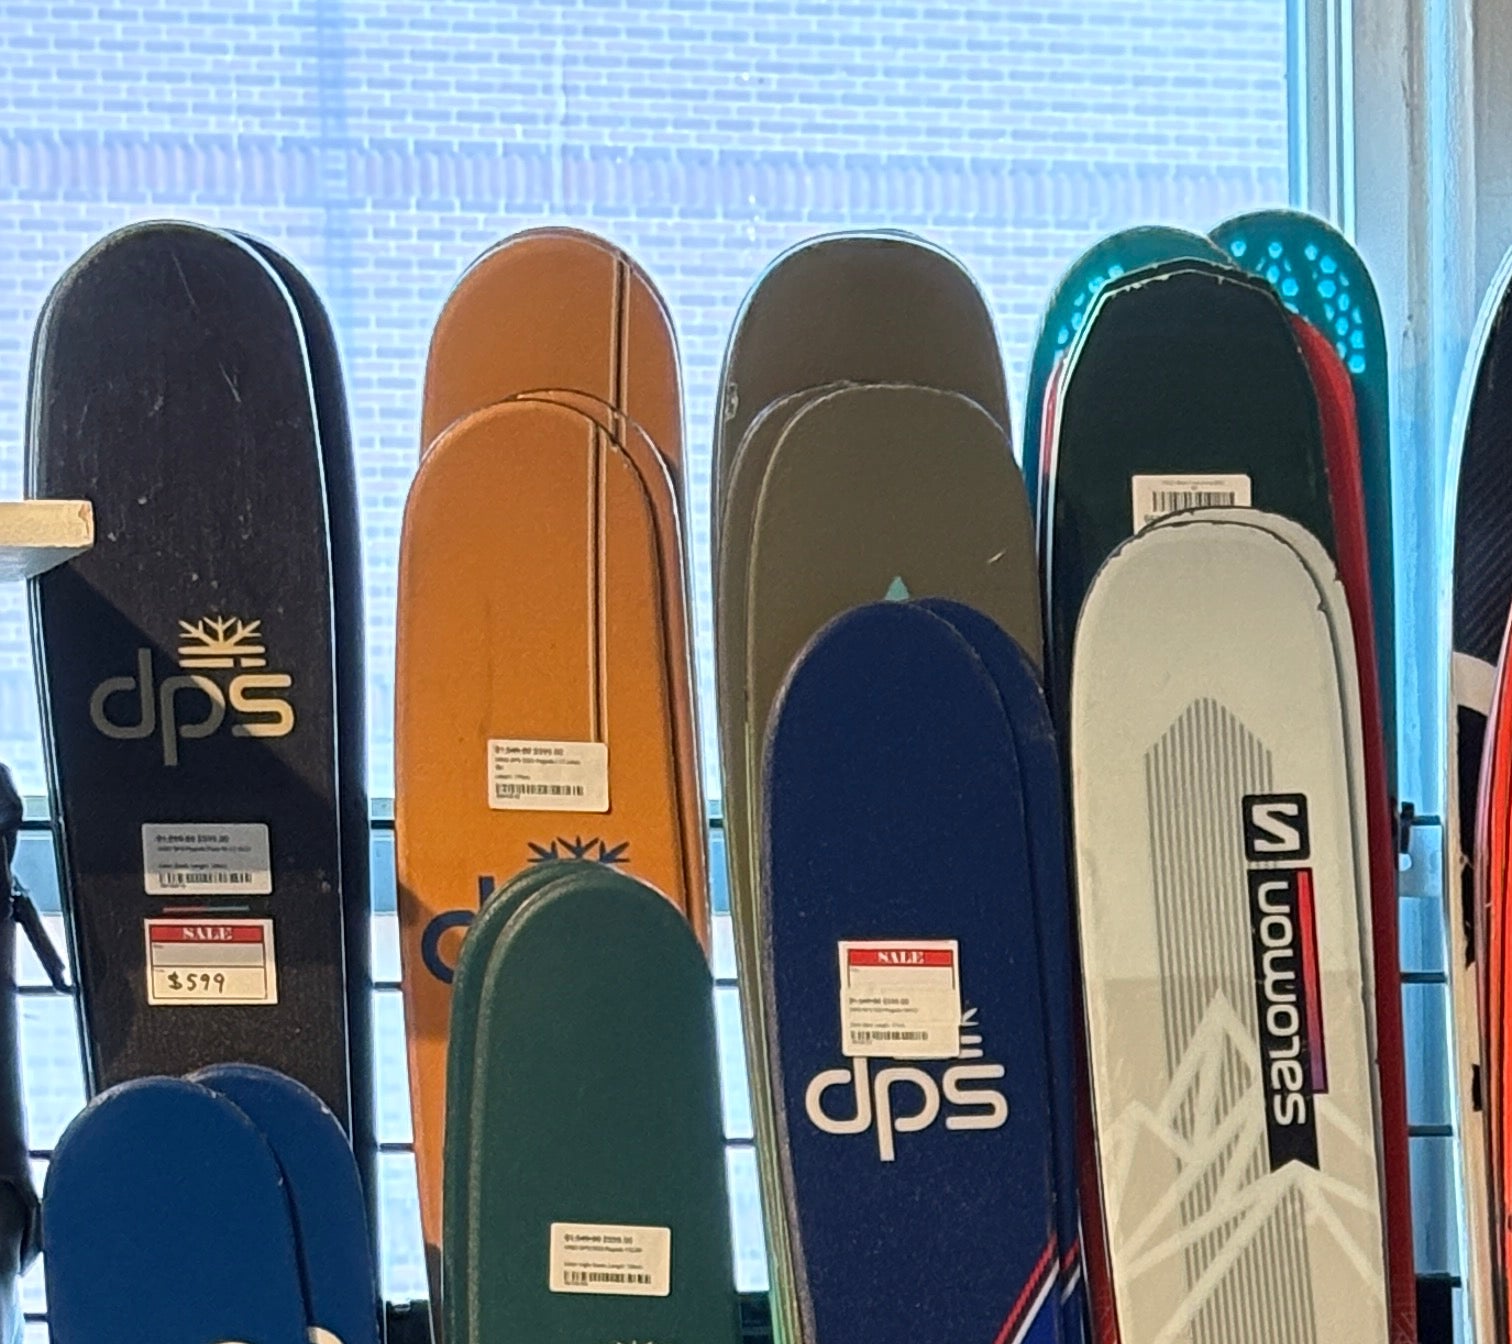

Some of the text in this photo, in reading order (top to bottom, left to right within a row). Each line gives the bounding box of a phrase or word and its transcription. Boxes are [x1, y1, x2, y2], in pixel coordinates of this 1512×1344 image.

[90, 647, 295, 766] dps
[182, 927, 233, 940] SALE
[878, 952, 924, 964] SALE
[168, 971, 225, 993] $599
[805, 1056, 1008, 1161] dps
